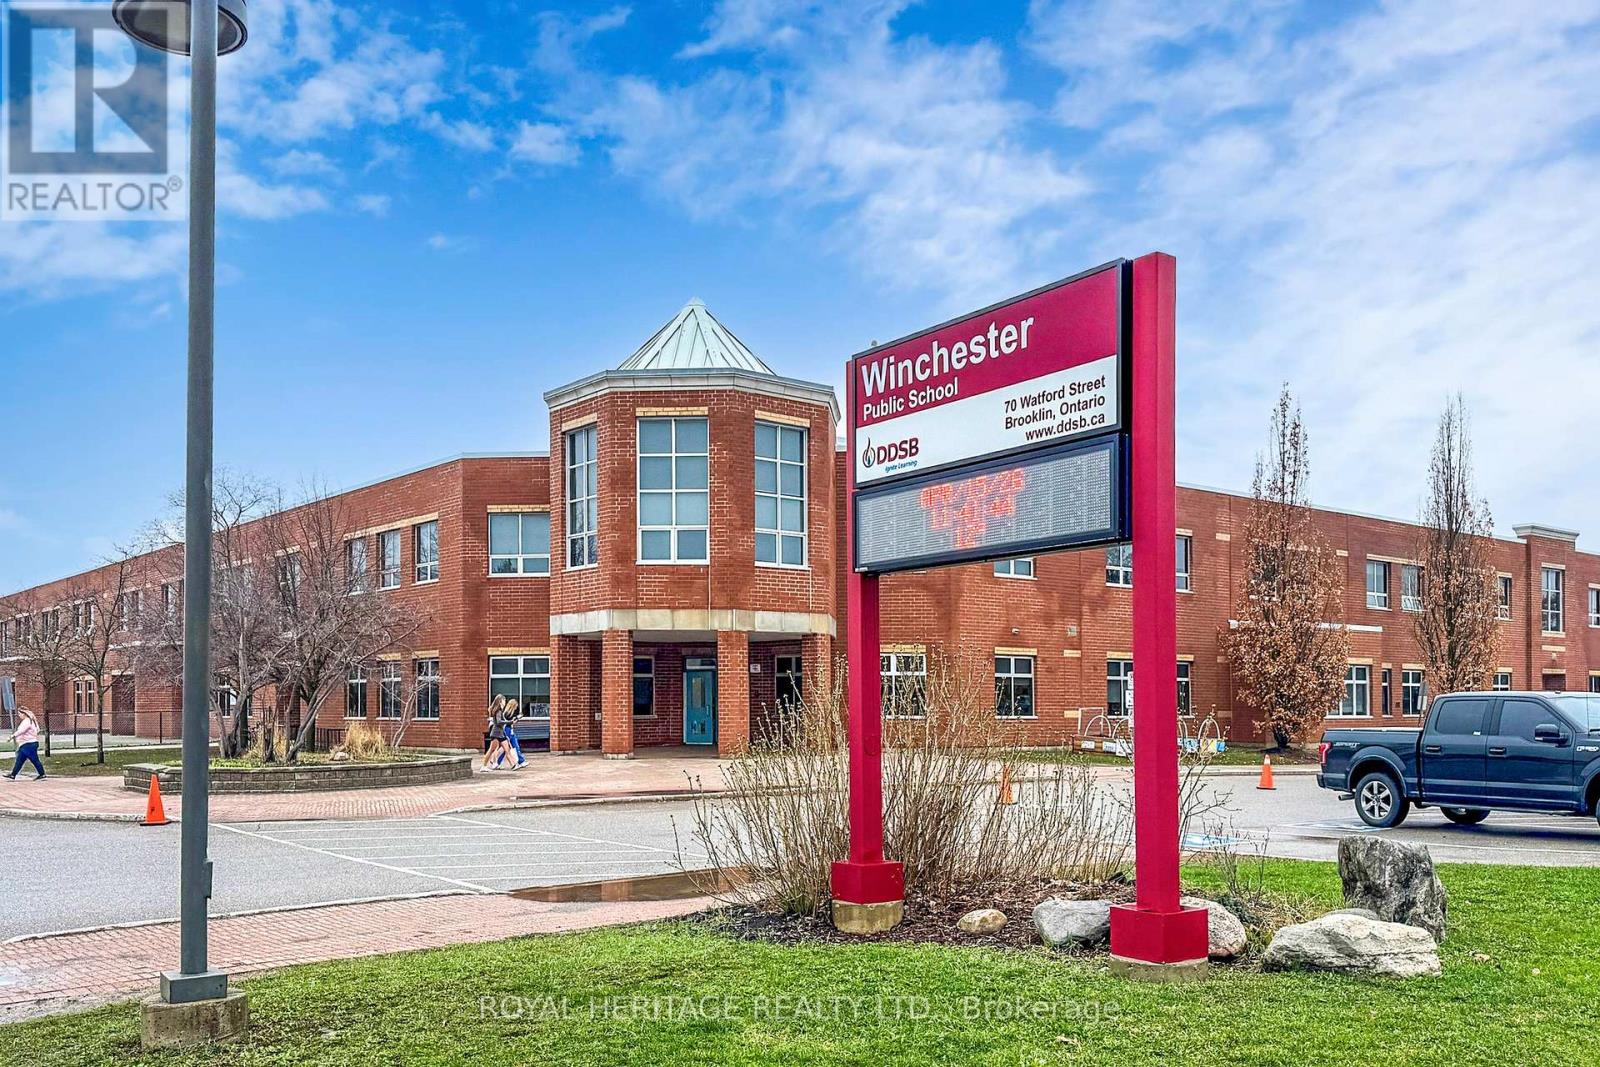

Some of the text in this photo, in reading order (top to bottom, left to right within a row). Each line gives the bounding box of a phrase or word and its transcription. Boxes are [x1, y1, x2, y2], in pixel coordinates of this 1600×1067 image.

[861, 316, 1035, 398] Winchester
[863, 377, 958, 421] Public School
[1004, 375, 1106, 414] 70 Watford Street
[1005, 394, 1105, 430] Brooklin, Ontario
[1025, 413, 1105, 441] www.ddsb.ca
[877, 437, 919, 465] DDSB
